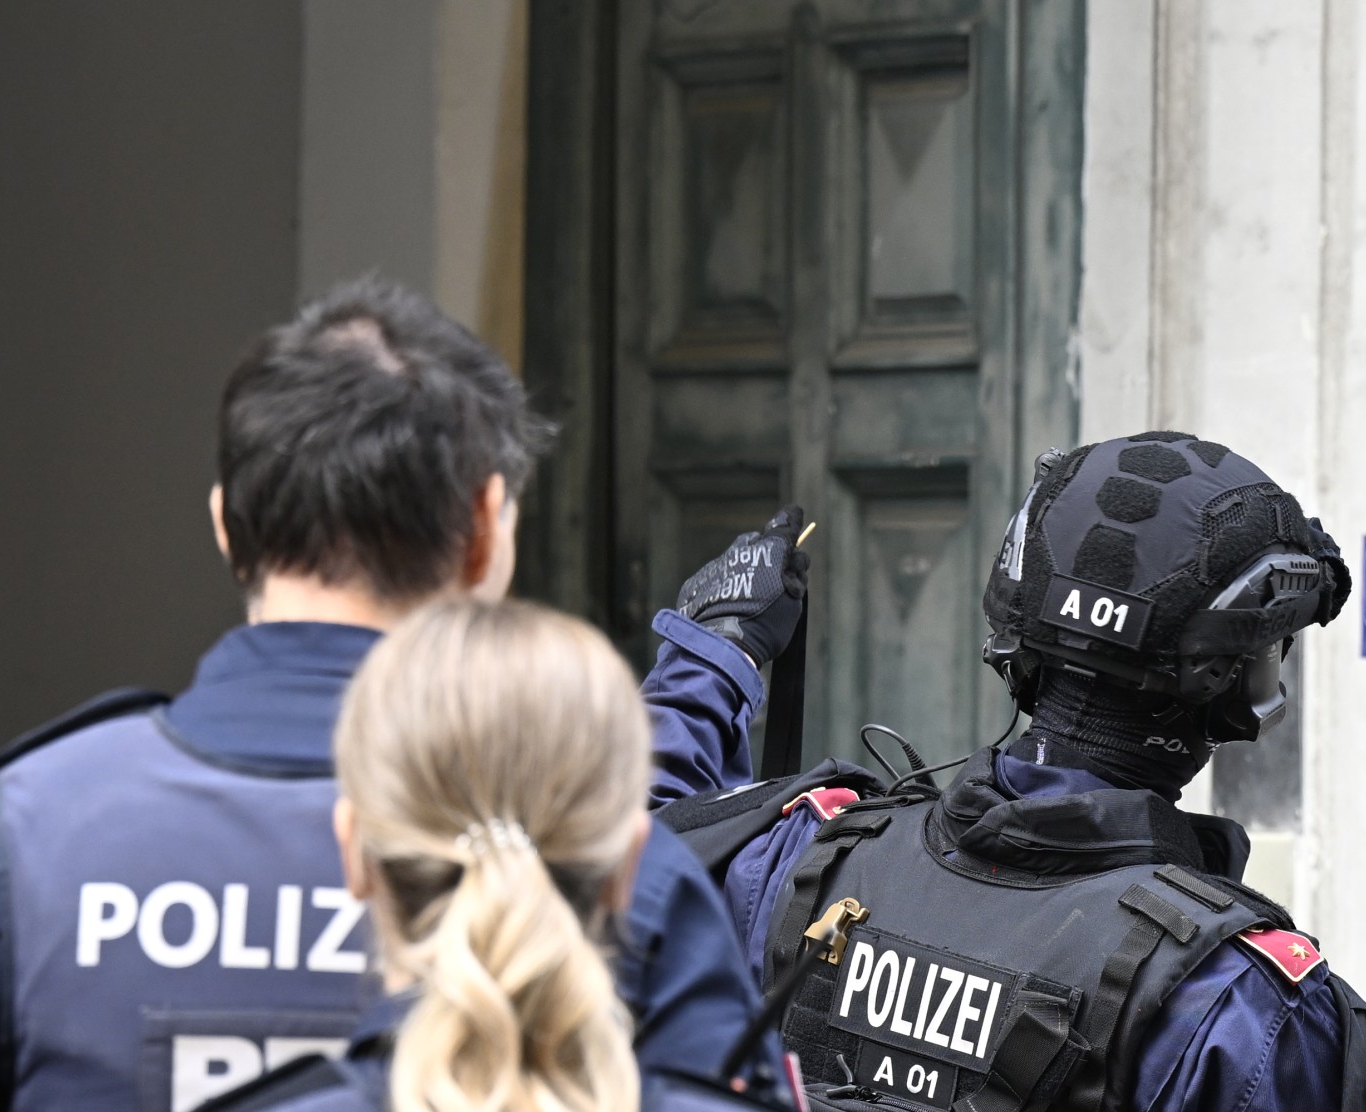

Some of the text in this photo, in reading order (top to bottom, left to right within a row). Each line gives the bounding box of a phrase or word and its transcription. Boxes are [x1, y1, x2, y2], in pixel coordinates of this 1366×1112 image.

[1058, 588, 1130, 634] A 01
[75, 880, 369, 974] POLIZ
[838, 940, 1004, 1060] POLIZEI
[871, 1054, 940, 1100] A 01
